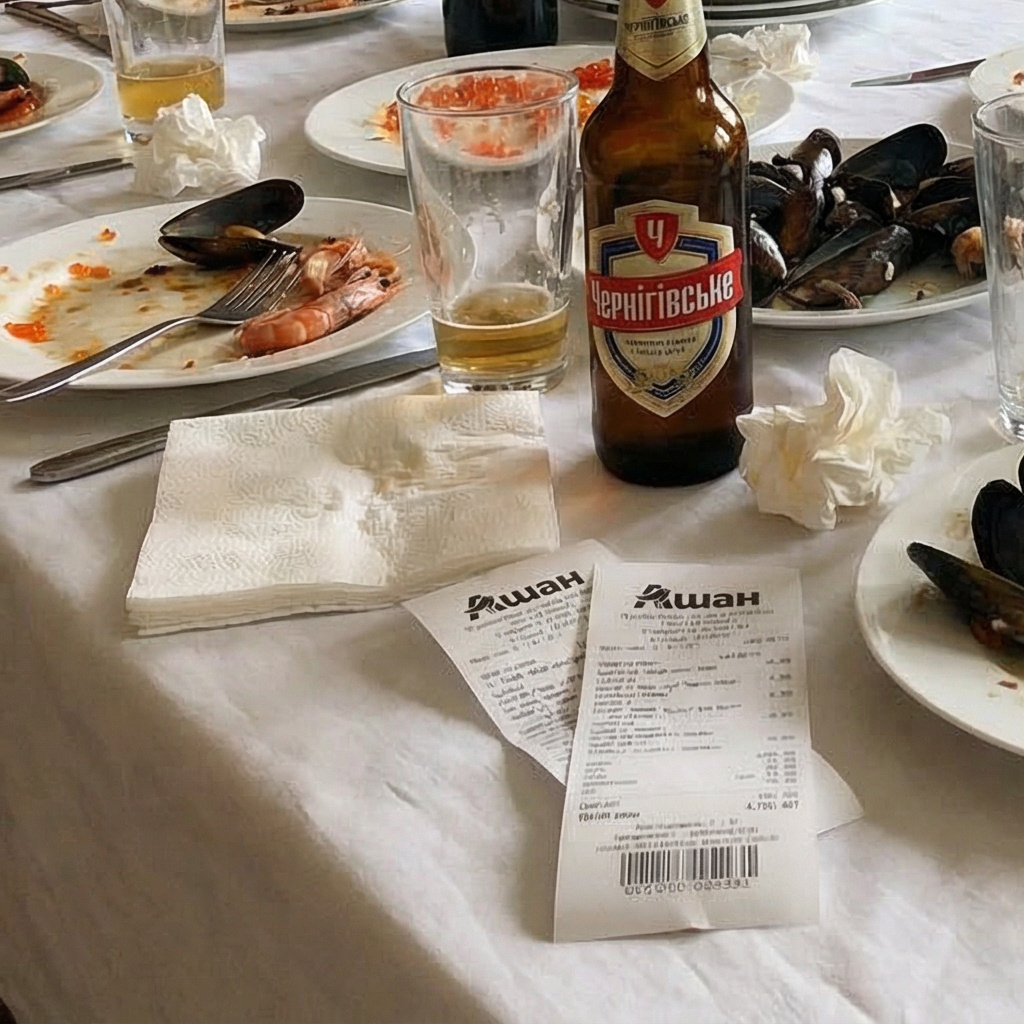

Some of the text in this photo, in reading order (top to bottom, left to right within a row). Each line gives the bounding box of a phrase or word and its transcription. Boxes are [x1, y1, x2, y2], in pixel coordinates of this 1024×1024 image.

[646, 219, 664, 249] Ч
[590, 269, 734, 322] Чернігівське
[463, 570, 586, 622] Ашан
[633, 583, 760, 610] Ашан
